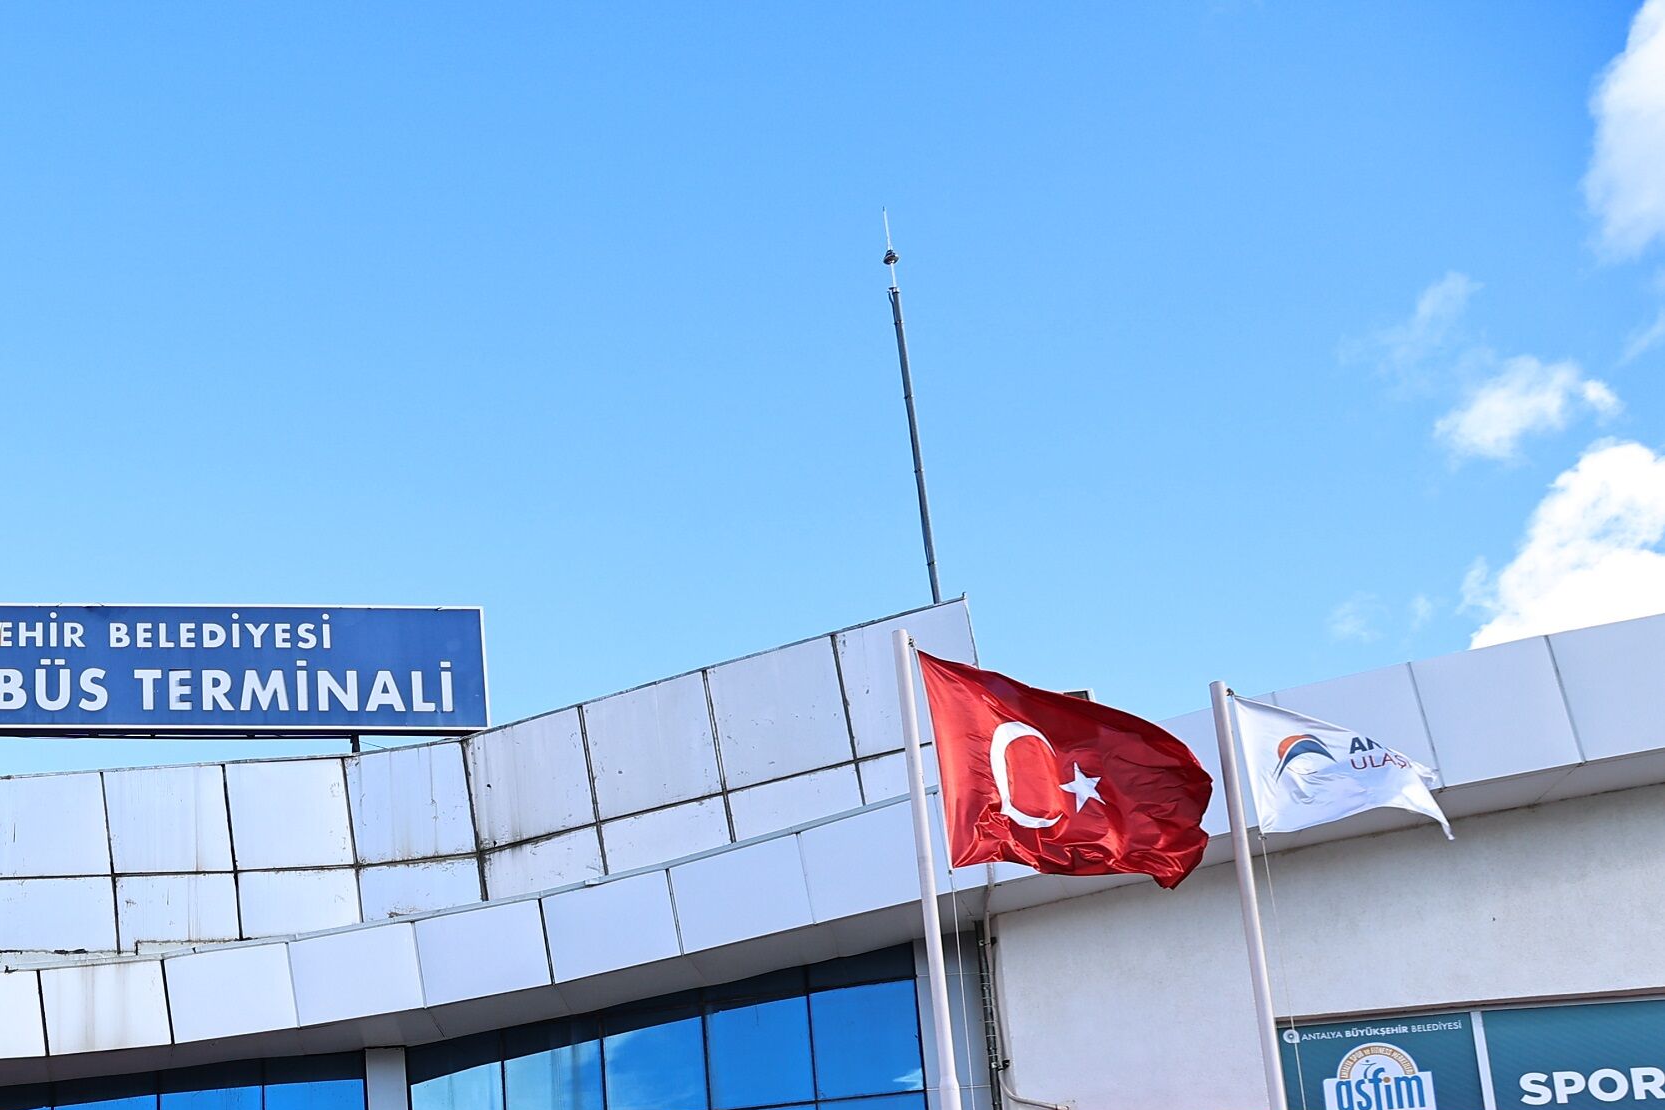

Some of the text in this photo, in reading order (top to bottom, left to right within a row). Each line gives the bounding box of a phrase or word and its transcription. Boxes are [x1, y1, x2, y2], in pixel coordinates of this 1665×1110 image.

[109, 612, 332, 650] BELEDİYESİ
[134, 659, 454, 713] TERMİNALİ
[1301, 1020, 1462, 1042] ANTALYA BÜYÜKŞEHİR BELEDİYESİ
[1519, 1066, 1665, 1106] SPOR
